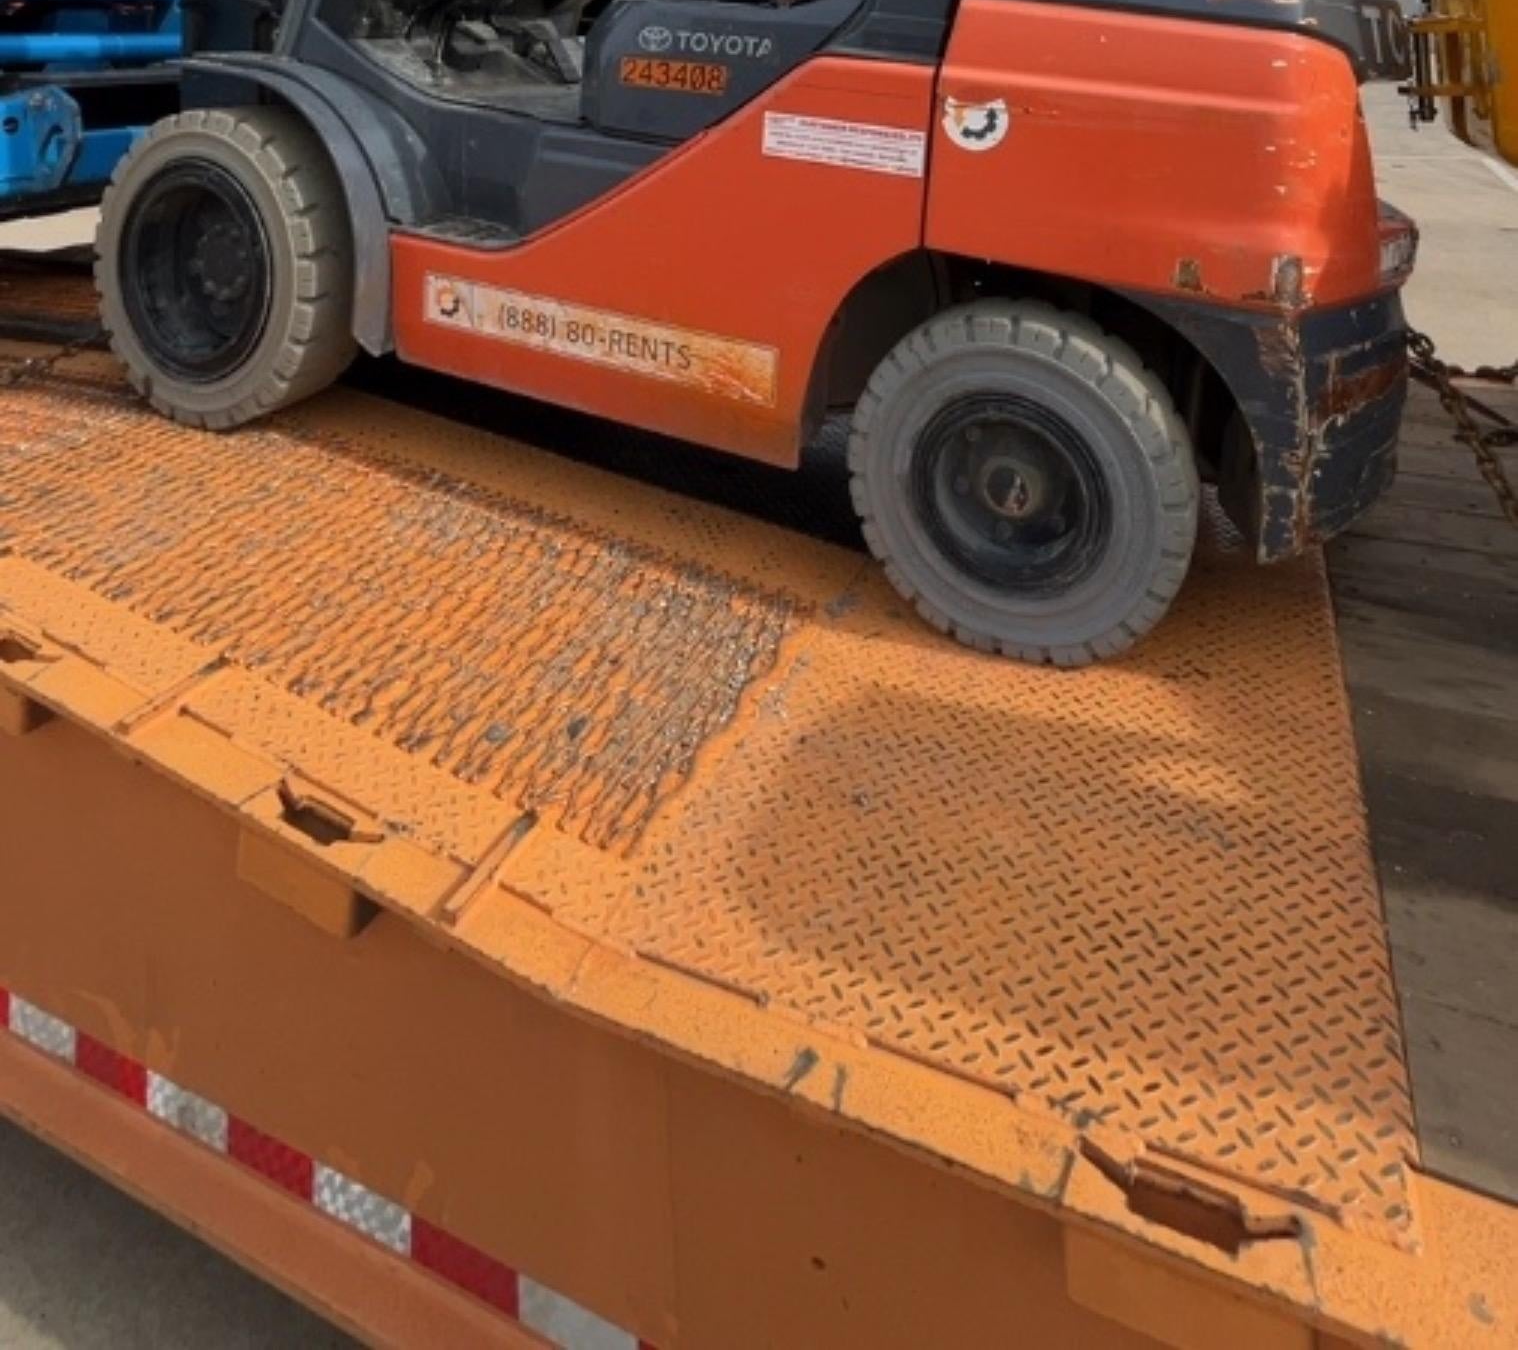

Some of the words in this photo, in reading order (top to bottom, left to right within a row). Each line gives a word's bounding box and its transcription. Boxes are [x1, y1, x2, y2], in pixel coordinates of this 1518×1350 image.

[676, 31, 773, 58] TOYOTA
[623, 57, 726, 91] 243408
[499, 304, 556, 339] (888)
[566, 320, 691, 370] 80-RENTS
